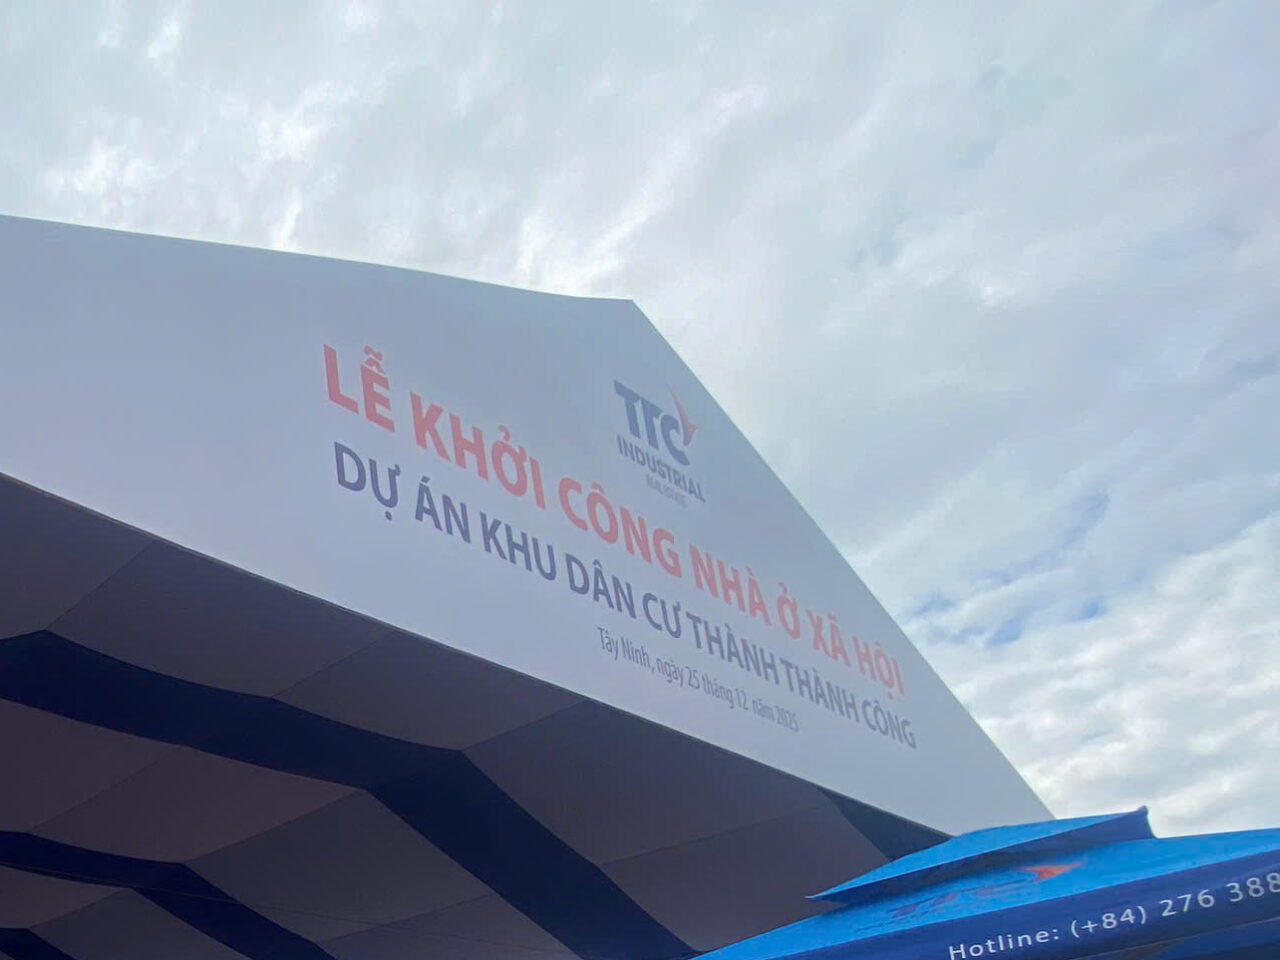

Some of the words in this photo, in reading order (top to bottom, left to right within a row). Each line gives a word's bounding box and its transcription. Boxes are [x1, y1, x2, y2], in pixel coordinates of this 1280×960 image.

[616, 433, 707, 503] INDUSTRIAL
[323, 343, 395, 432] LỄ
[410, 391, 546, 511] KHỞI
[558, 476, 683, 579] CÔNG
[689, 542, 772, 626] NHÀ
[776, 581, 801, 640] Ở
[805, 609, 852, 667] XÃ
[852, 635, 906, 700] HỘI
[333, 441, 401, 521] DỰ
[415, 475, 471, 545] ÁN
[479, 511, 557, 581] KHU
[565, 552, 637, 619] DÂN
[642, 592, 682, 639] CƯ
[685, 611, 780, 686] THÀNH
[779, 657, 861, 723] THÀNH
[861, 699, 918, 749] CÔNG
[597, 626, 619, 661] Tây
[656, 656, 684, 688] ngày
[684, 665, 701, 690] 25
[701, 673, 735, 710] tháng
[948, 926, 1060, 960] Hotline:
[1070, 905, 1147, 938] (+84)
[1159, 889, 1215, 917] 276
[1225, 872, 1280, 902] 388
